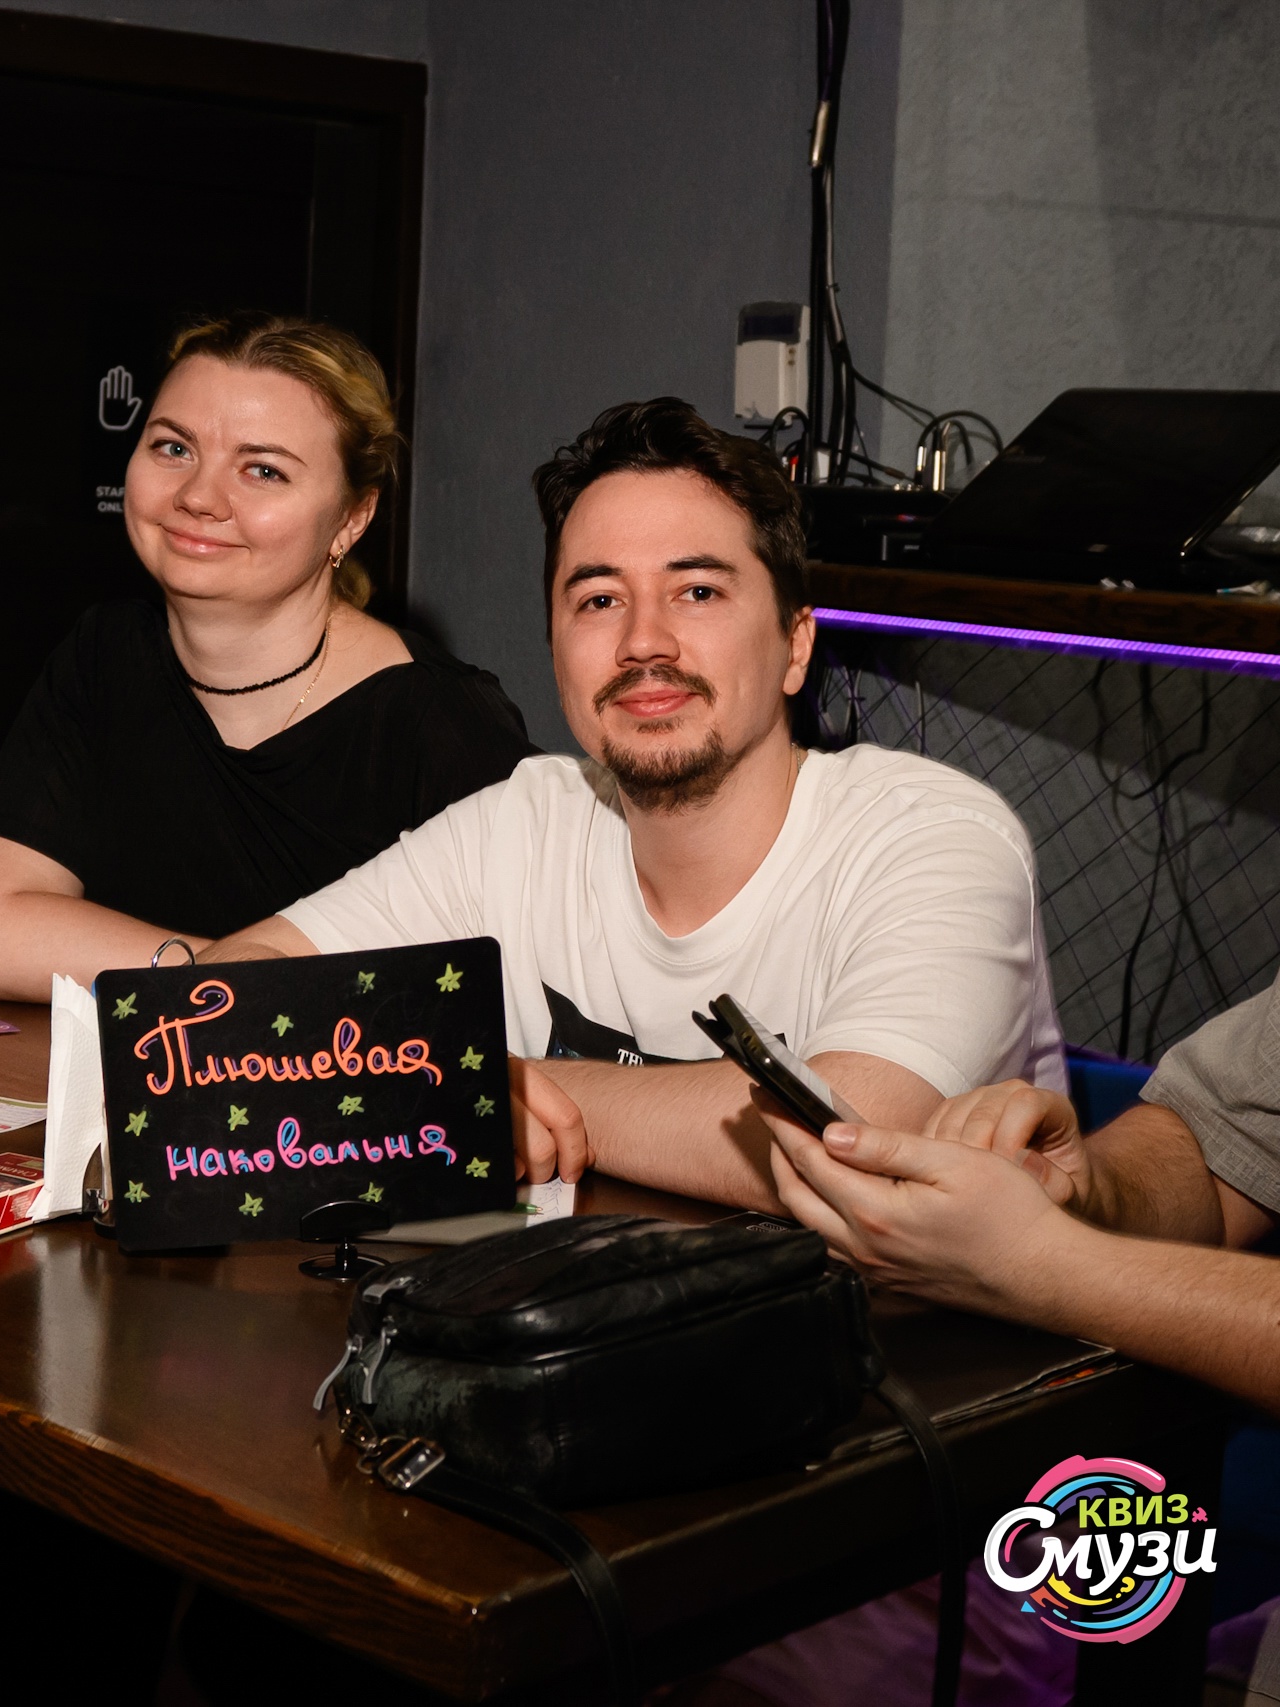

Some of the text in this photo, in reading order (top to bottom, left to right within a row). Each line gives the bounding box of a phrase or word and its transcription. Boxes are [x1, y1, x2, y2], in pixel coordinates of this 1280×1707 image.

[96, 486, 124, 497] STAF
[97, 502, 123, 512] ONL
[134, 980, 443, 1095] Плюшевая
[165, 1117, 457, 1182] наковальня
